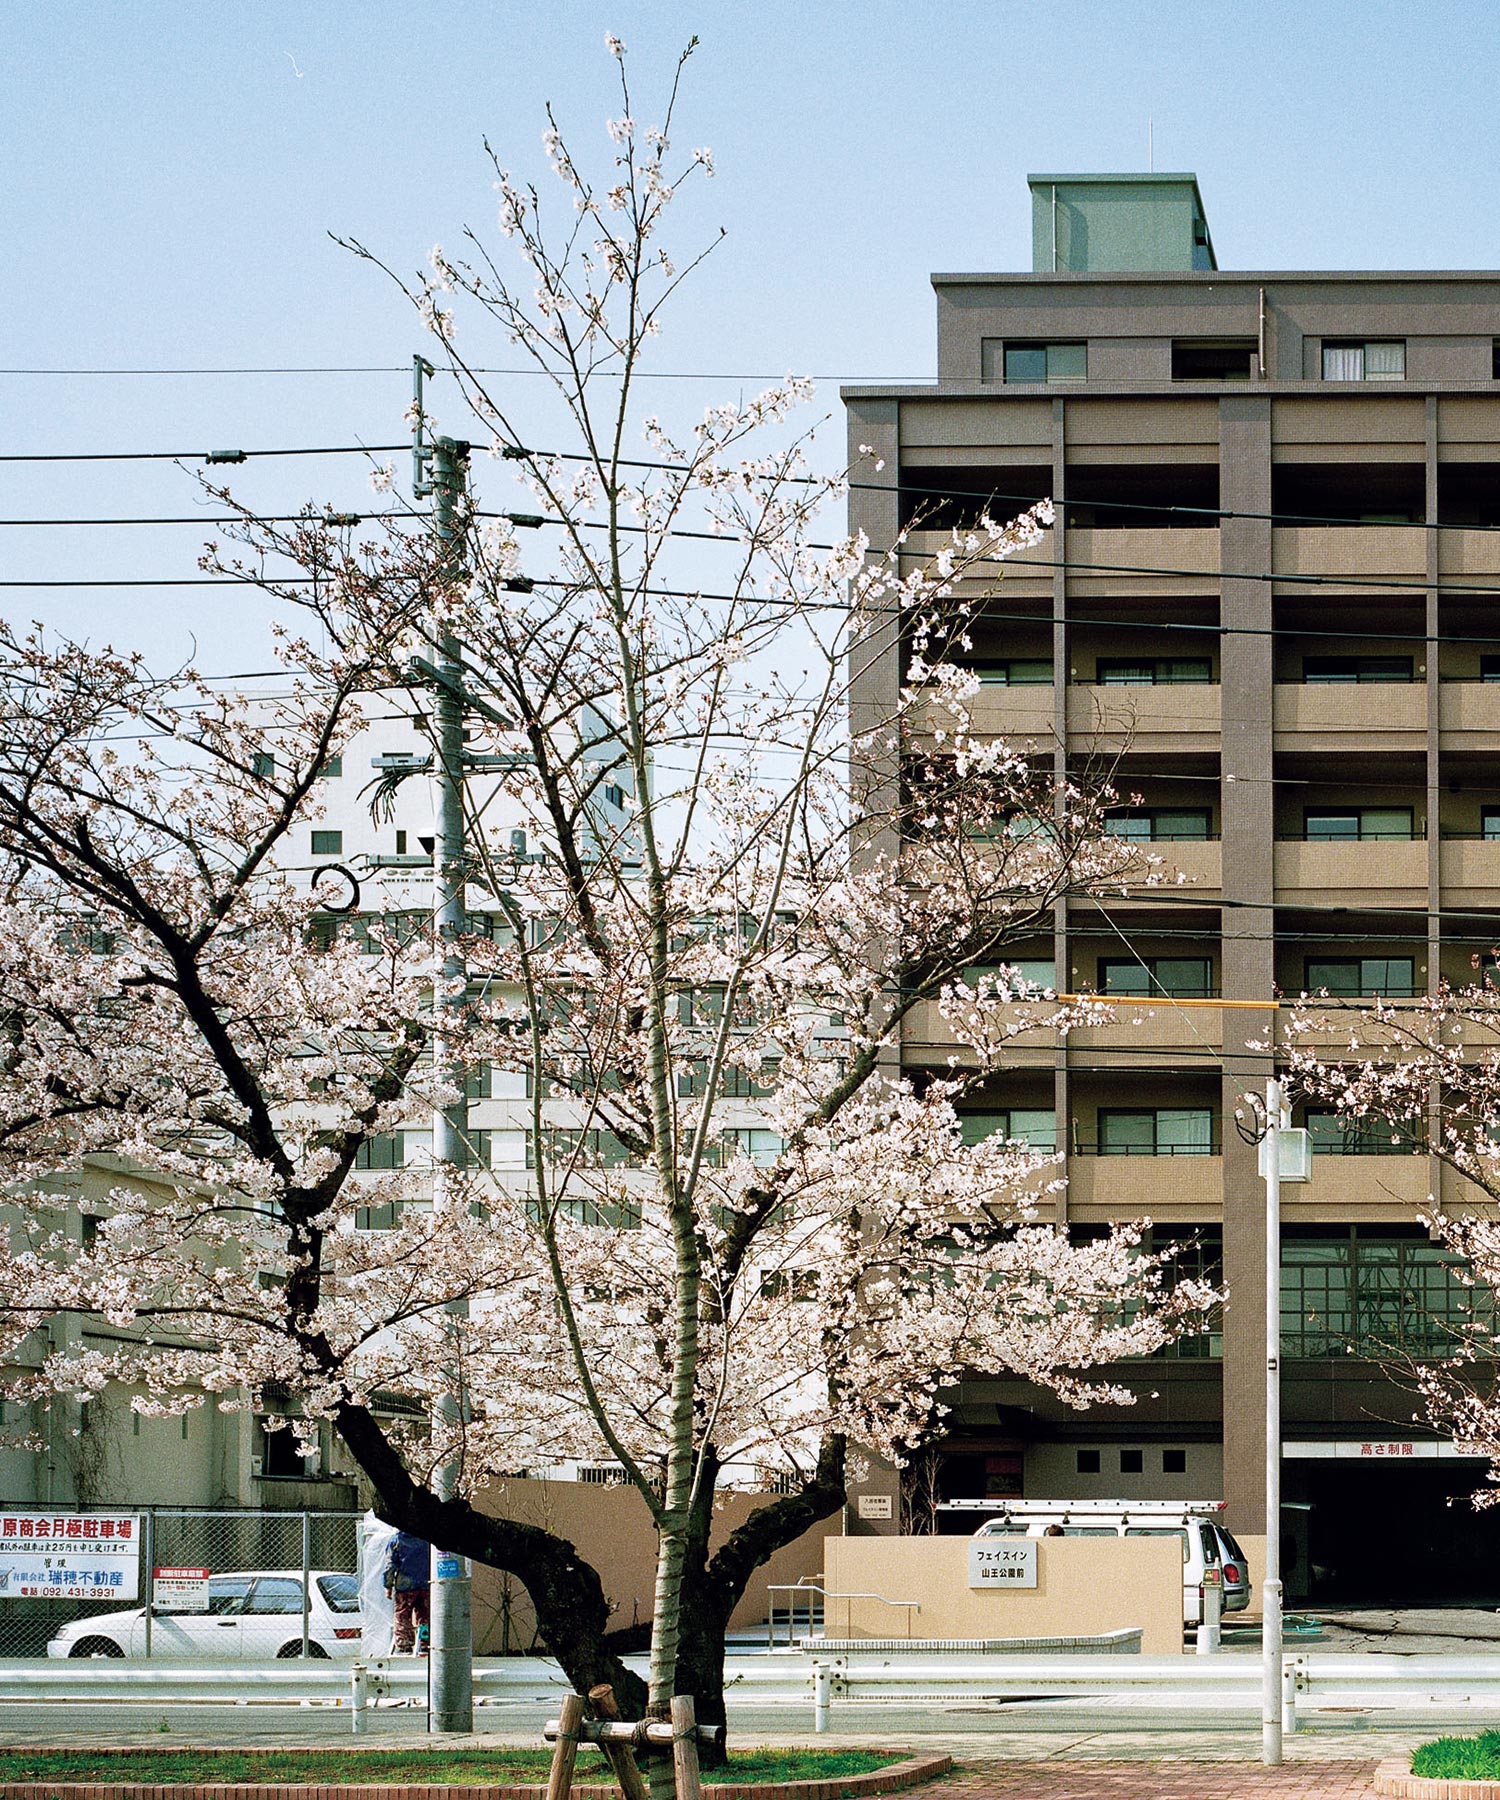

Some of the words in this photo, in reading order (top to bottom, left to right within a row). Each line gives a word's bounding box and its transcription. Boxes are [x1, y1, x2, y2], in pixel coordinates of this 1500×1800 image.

[1361, 1443, 1413, 1456] 高さ制限
[0, 1518, 132, 1538] 原商会月極駐車場
[13, 1572, 46, 1582] 有限会社
[48, 1570, 123, 1586] 瑞穂不動産
[982, 1567, 1025, 1578] 山王公園前
[21, 1587, 38, 1596] 電話
[67, 1588, 115, 1597] 431-3931
